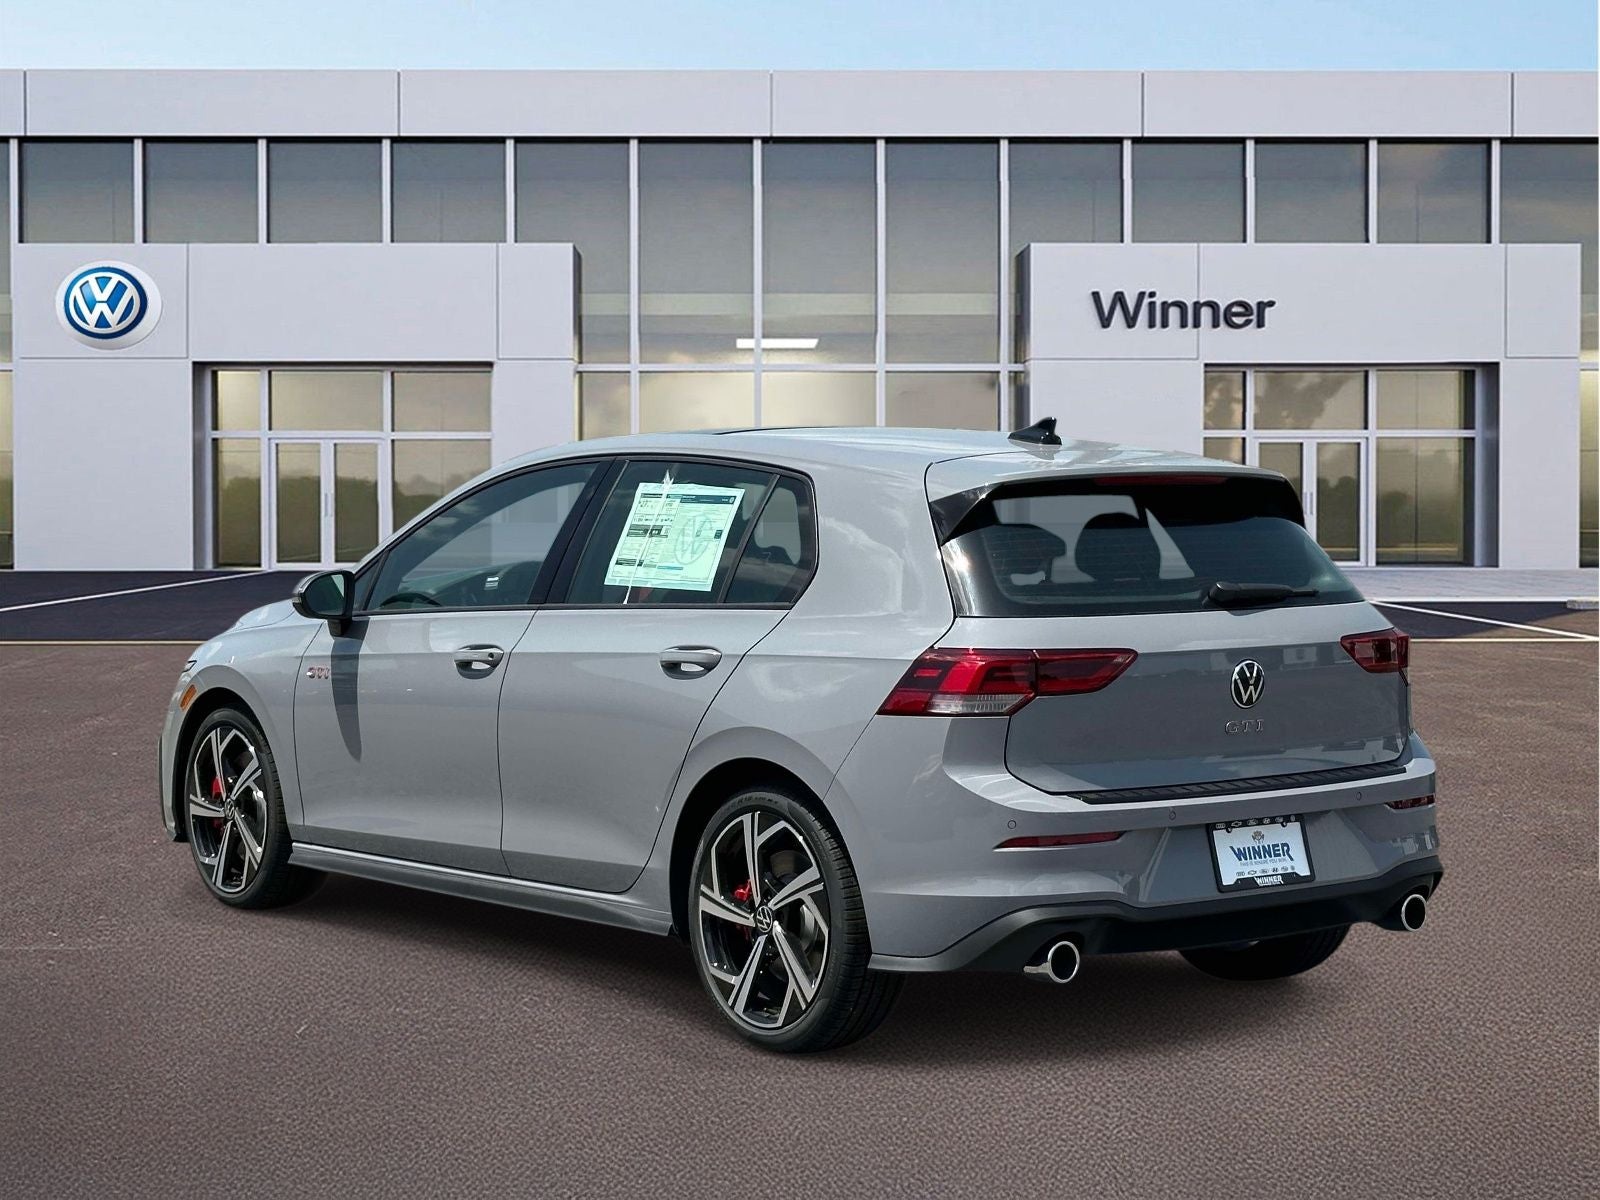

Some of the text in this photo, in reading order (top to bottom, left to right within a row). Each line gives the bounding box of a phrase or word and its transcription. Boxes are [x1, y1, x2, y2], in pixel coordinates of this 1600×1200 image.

[67, 270, 143, 336] VW
[1091, 290, 1276, 329] Winner
[1231, 660, 1264, 708] VW
[1225, 719, 1265, 733] GTI
[1229, 842, 1294, 862] WINNER
[1254, 875, 1284, 887] WINNER
